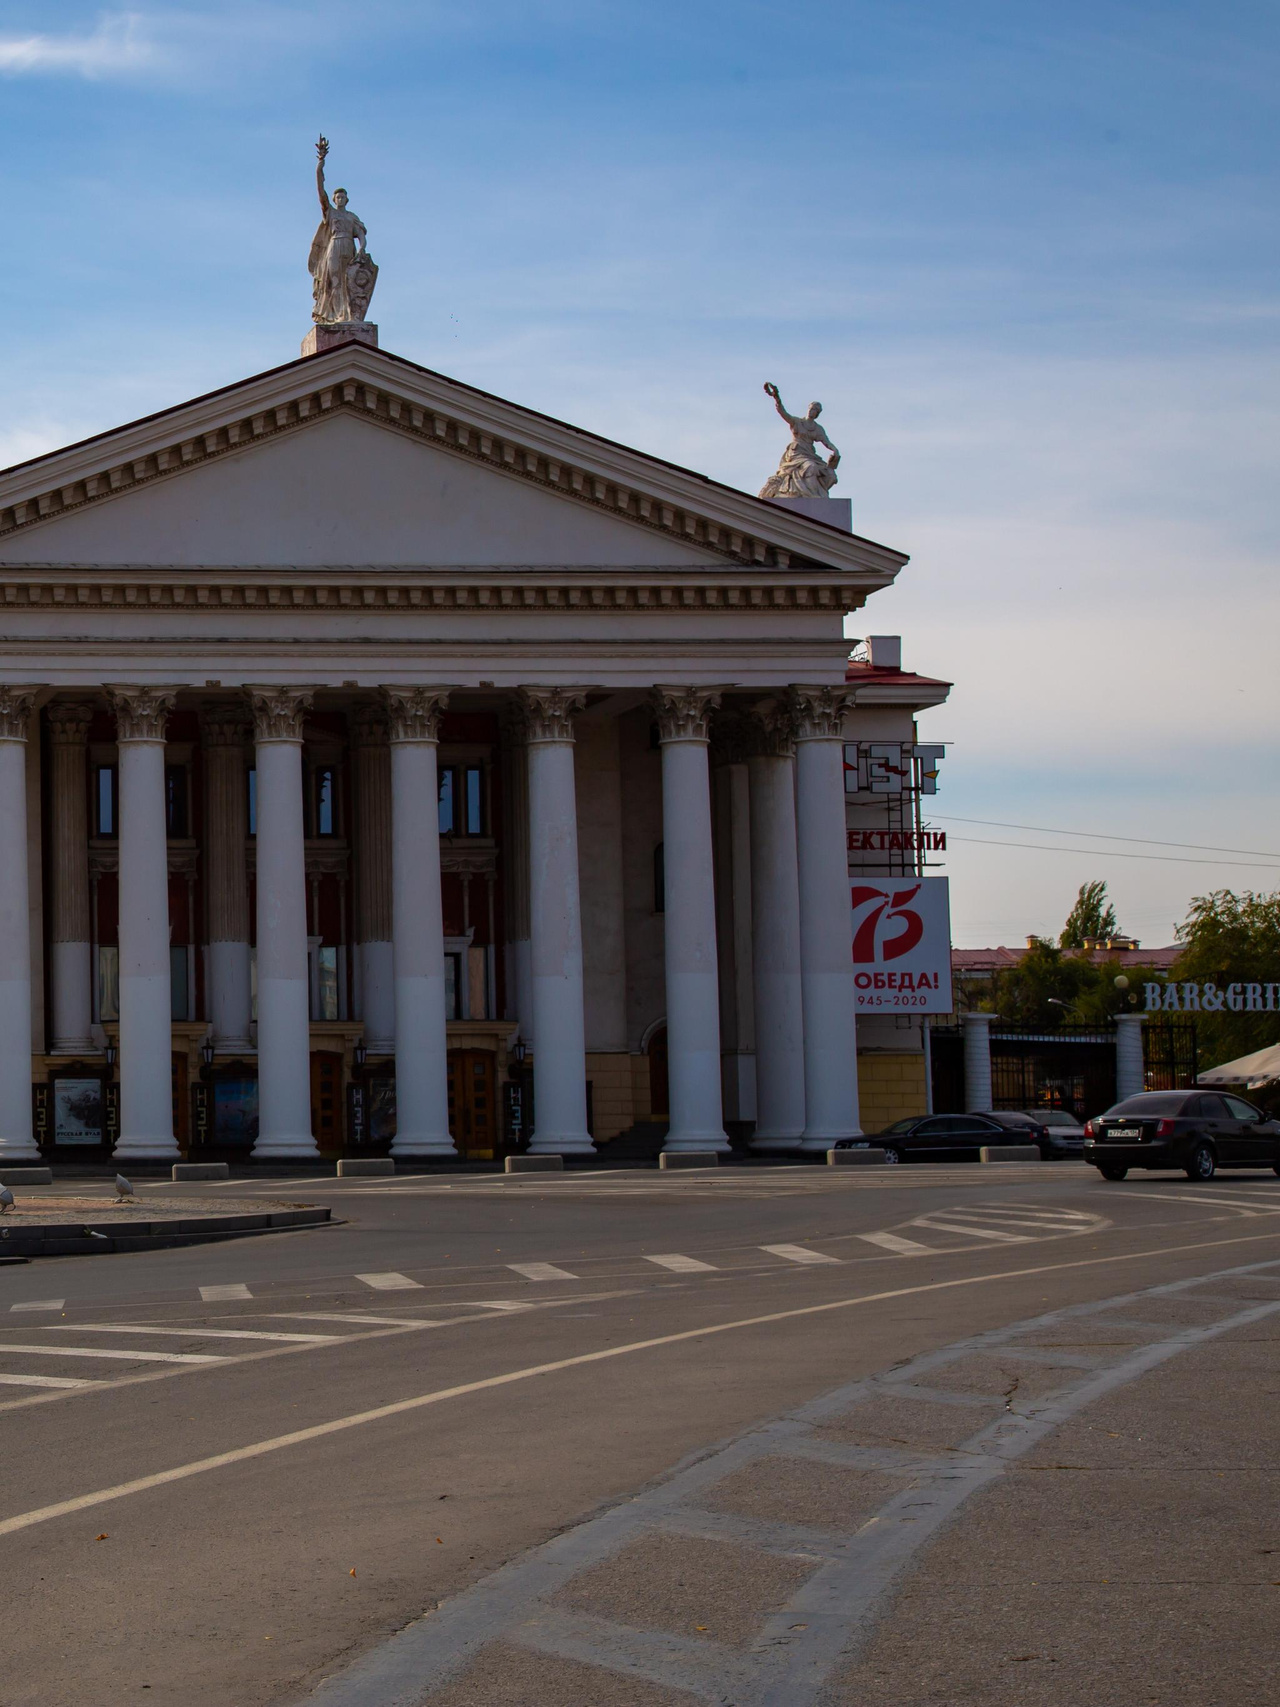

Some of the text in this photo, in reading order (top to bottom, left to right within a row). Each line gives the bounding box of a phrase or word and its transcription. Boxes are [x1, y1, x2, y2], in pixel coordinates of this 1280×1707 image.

[847, 831, 946, 850] ЕКТАКЛИ
[851, 883, 923, 963] 75
[854, 972, 939, 993] ОБЕДА!
[1142, 982, 1280, 1012] BAR&GRI
